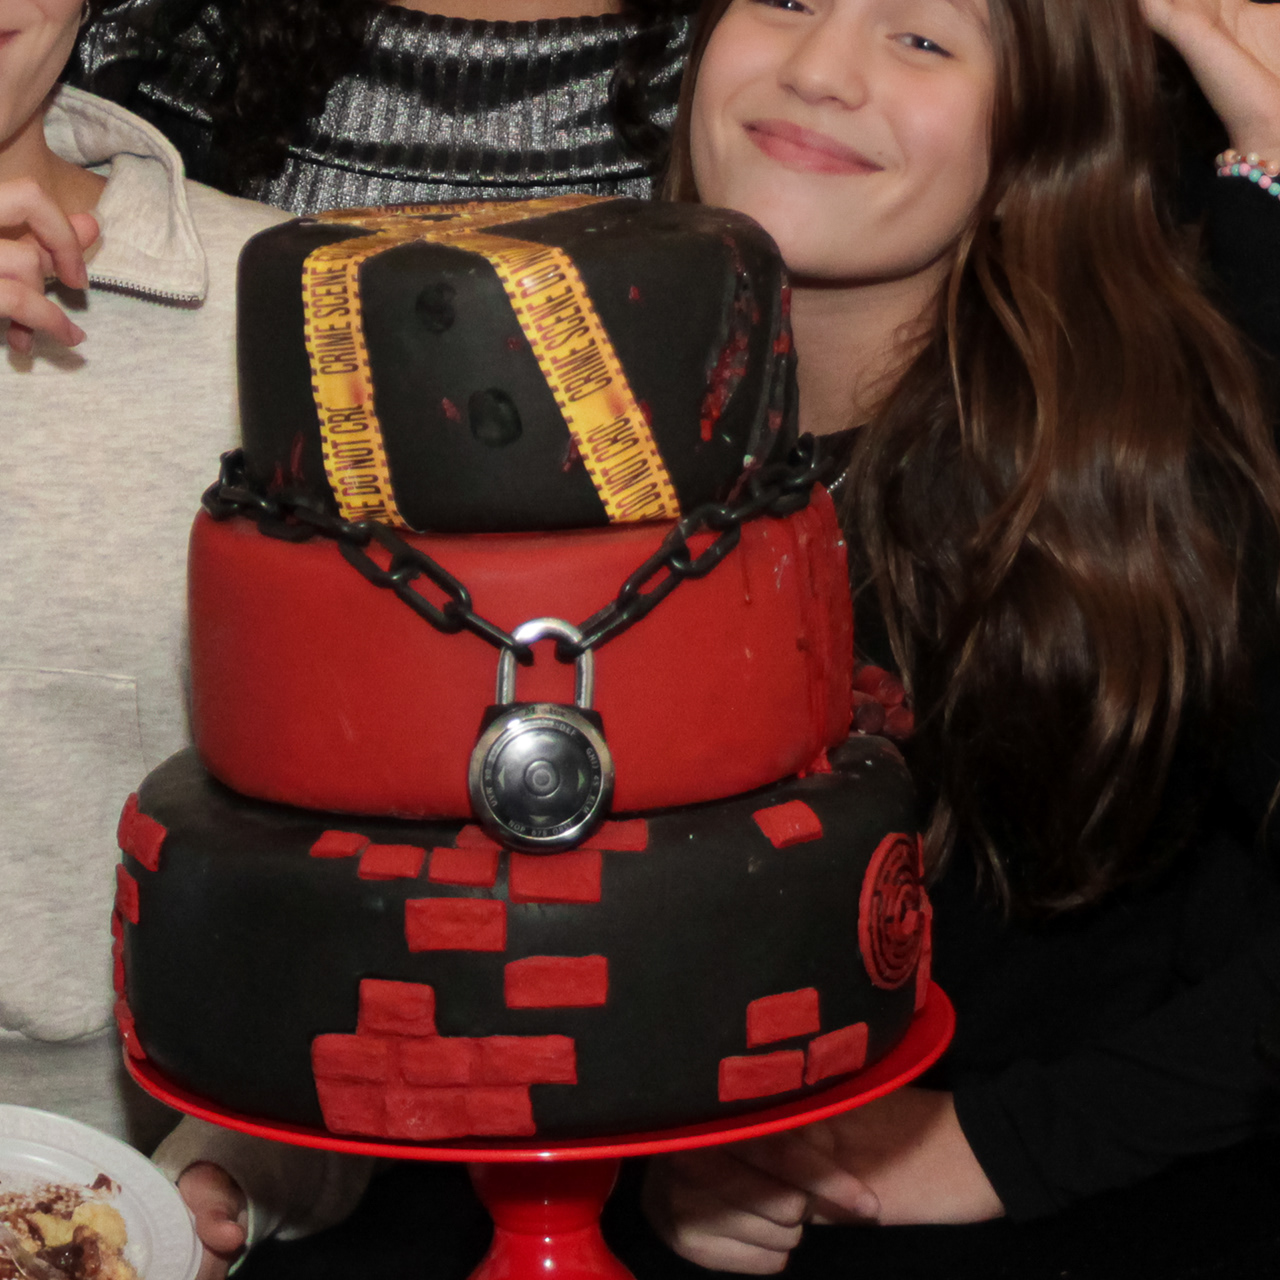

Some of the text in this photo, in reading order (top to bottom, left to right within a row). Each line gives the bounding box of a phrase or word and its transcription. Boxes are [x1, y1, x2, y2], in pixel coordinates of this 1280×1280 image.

[309, 263, 351, 320] SCENE
[313, 321, 360, 376] CRIME
[525, 285, 590, 361] SCENE
[549, 337, 613, 402] CRIME
[331, 439, 377, 472] NOT
[600, 450, 654, 498] NOT
[337, 473, 382, 497] DO
[615, 482, 662, 519] DO
